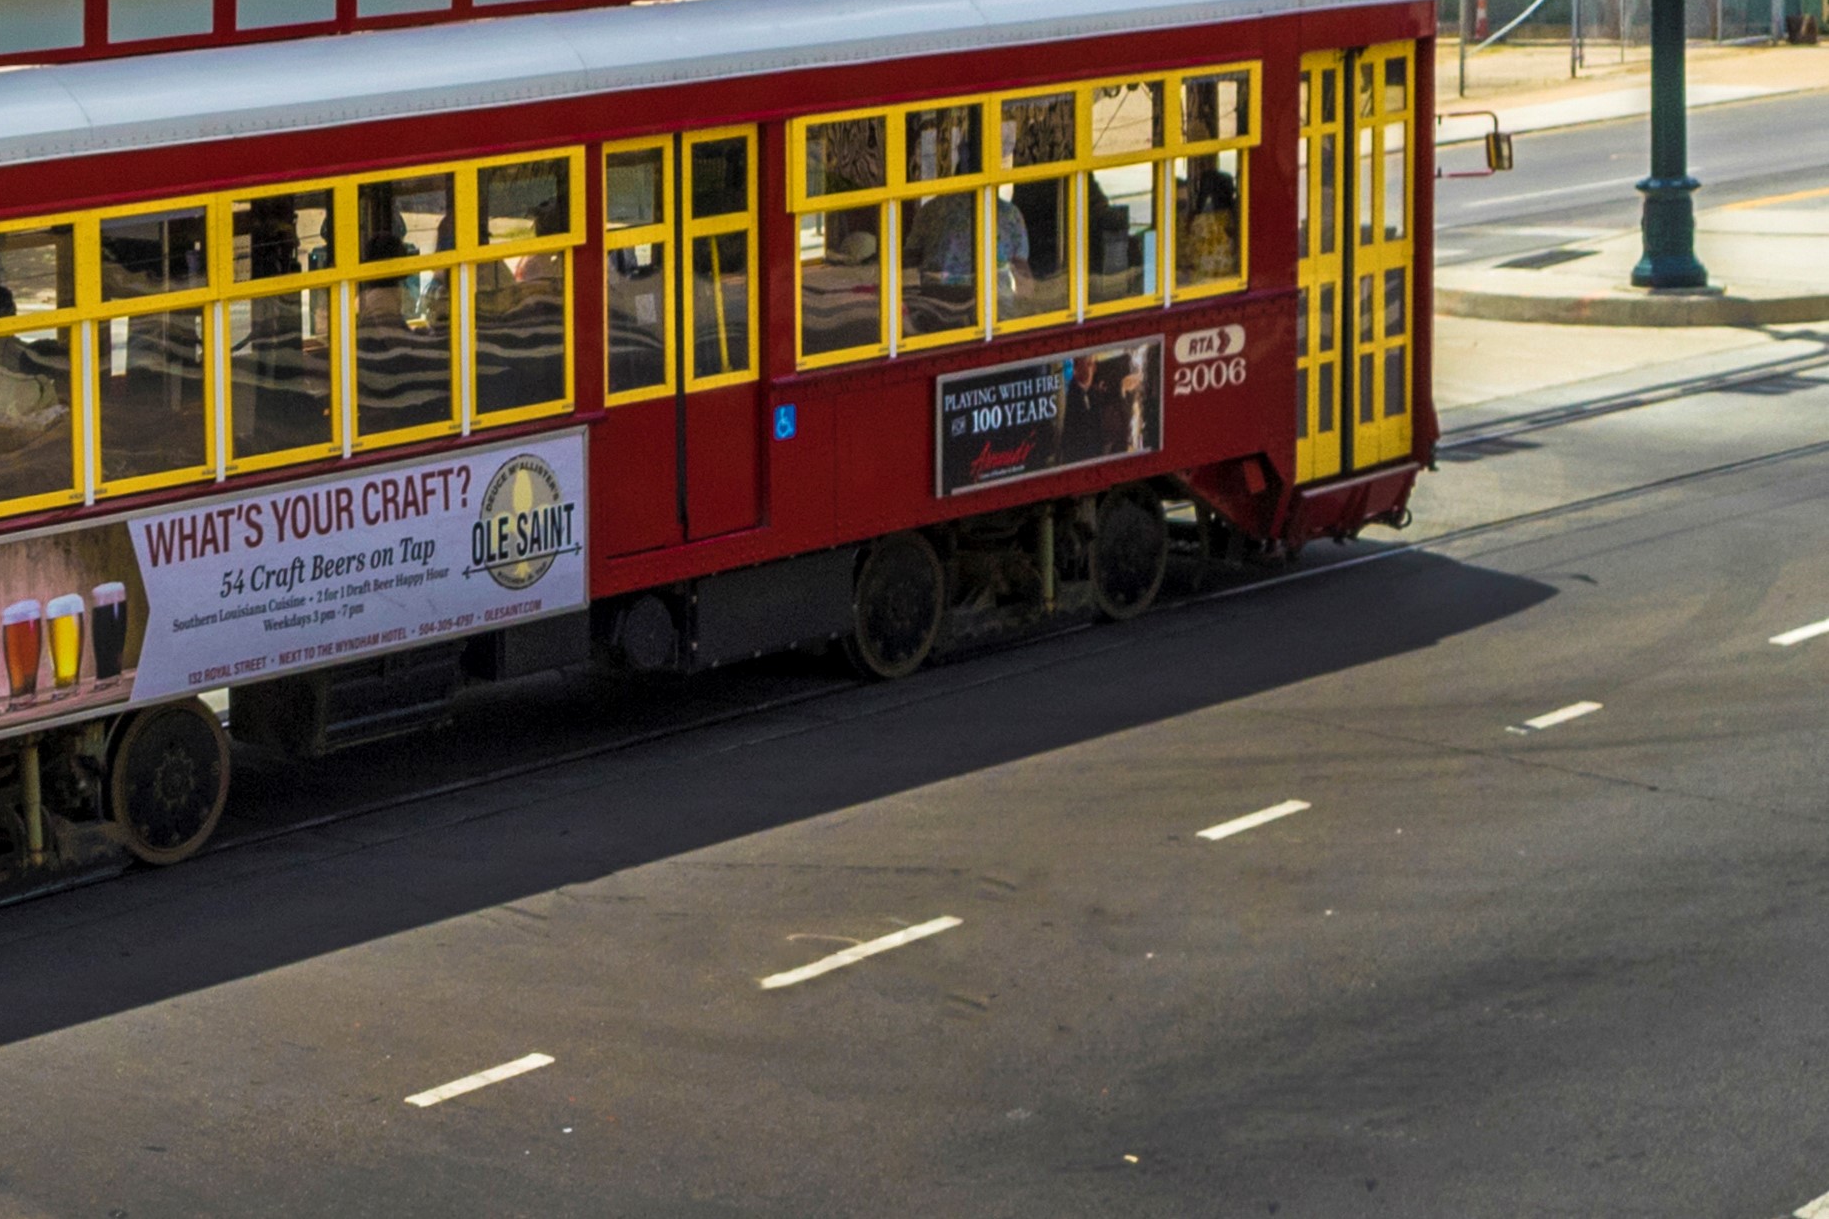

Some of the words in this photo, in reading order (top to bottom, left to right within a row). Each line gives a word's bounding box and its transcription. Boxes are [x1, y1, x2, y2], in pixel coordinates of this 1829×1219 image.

[1188, 335, 1214, 357] RTA
[944, 385, 997, 413] PLAYING
[998, 379, 1033, 401] WITH
[1035, 375, 1062, 394] FIRE
[1173, 356, 1247, 397] 2006
[971, 405, 1003, 434] 100
[1004, 395, 1059, 428] YEARS
[485, 471, 508, 512] DEUCE
[144, 502, 264, 568] WHAT'S
[270, 486, 354, 543] YOUR
[362, 465, 471, 527] CRAFT?
[472, 516, 509, 566] OLE
[516, 502, 575, 557] SAINT
[220, 568, 246, 599] 54
[250, 556, 306, 593] Craft
[310, 553, 366, 582] Beers
[370, 546, 396, 569] on
[399, 536, 436, 566] Tap
[173, 613, 218, 633] Southern
[219, 603, 267, 622] Louisiana
[268, 596, 306, 613] Cuisine
[317, 591, 323, 603] 2
[323, 587, 339, 601] for
[346, 581, 371, 597] Draft
[373, 578, 394, 592] Beer
[395, 572, 424, 589] Happy
[426, 567, 449, 580] Hour
[263, 613, 312, 632] Weekdays
[342, 604, 349, 617] 7
[204, 665, 232, 681] ROYAL
[233, 656, 268, 675] STREET
[278, 649, 302, 666] NEXT
[304, 647, 316, 661] TO
[317, 643, 334, 657] THE
[335, 633, 380, 653] WYNDHAM
[381, 627, 408, 644] HOTEL
